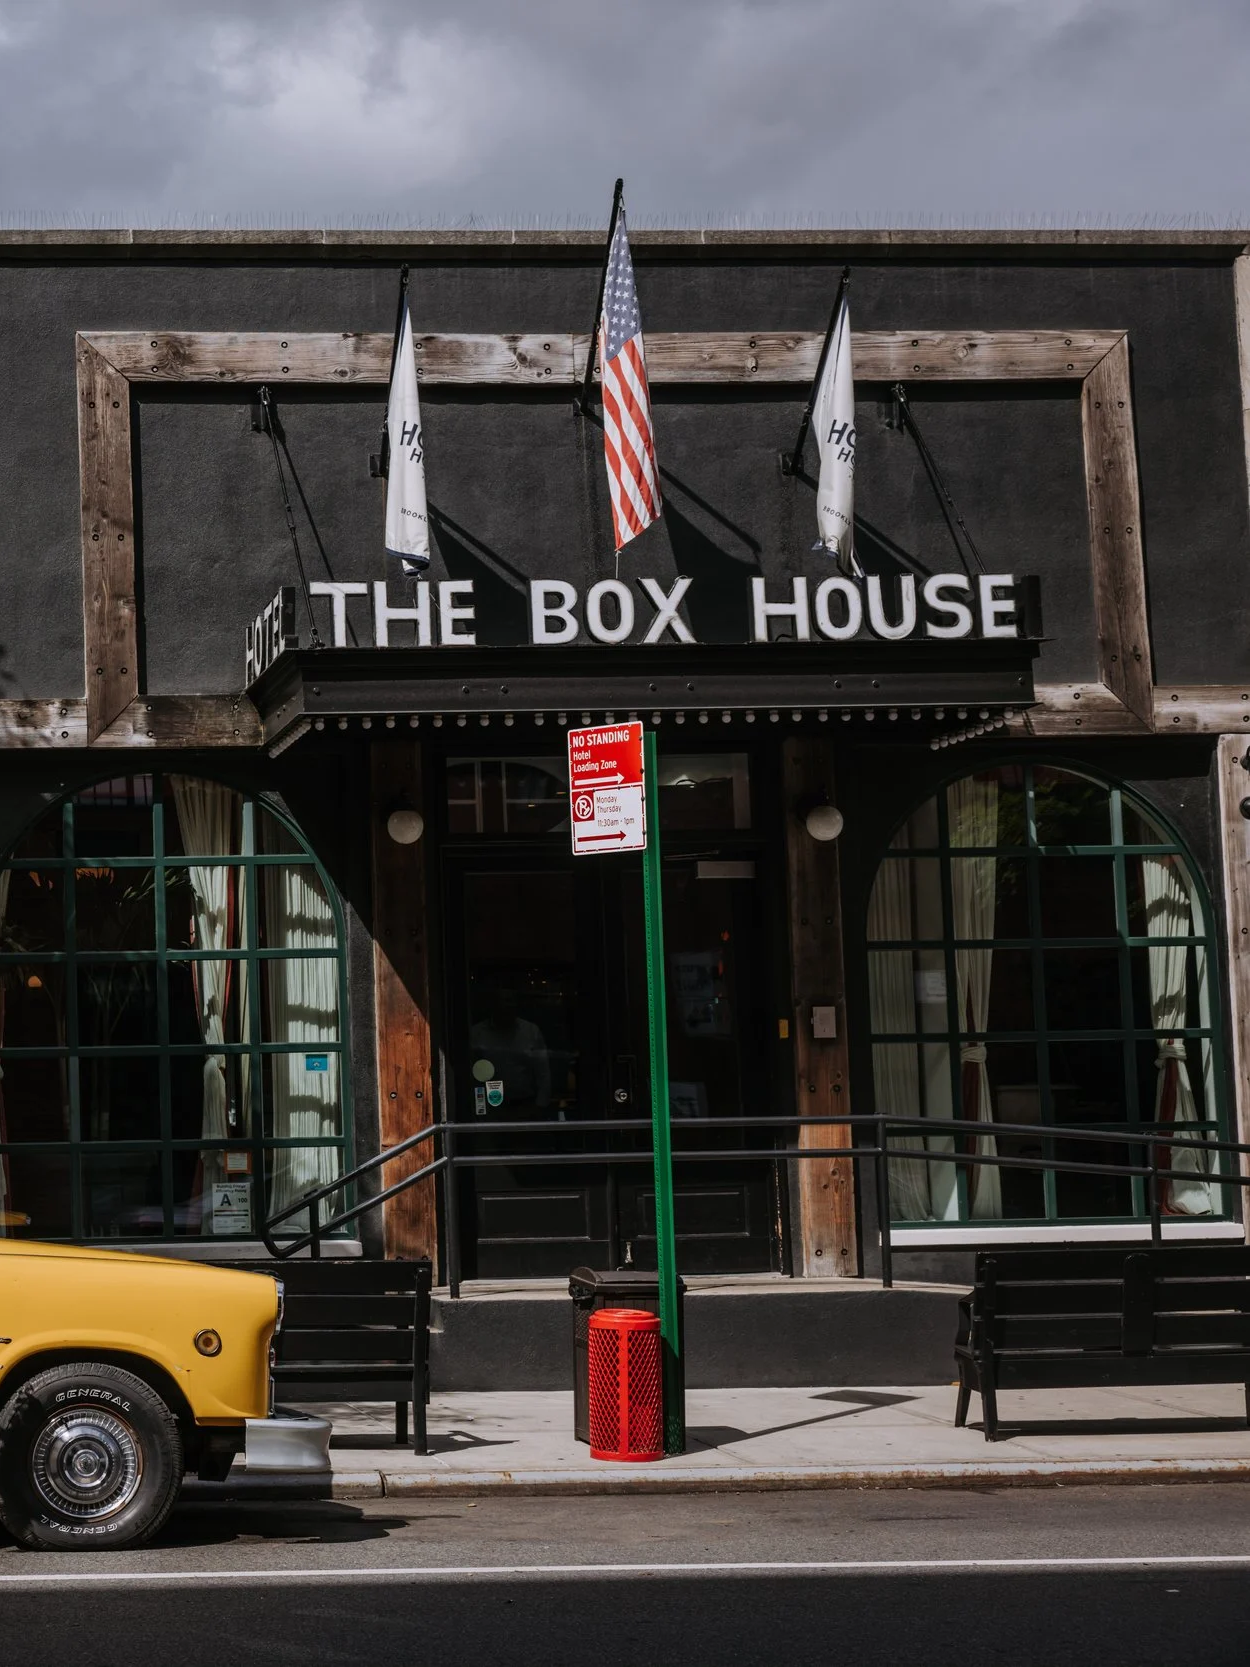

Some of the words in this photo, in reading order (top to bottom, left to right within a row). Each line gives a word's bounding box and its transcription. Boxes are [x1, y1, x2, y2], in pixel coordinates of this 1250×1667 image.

[310, 580, 476, 648] THE
[531, 578, 697, 645] BOX
[751, 573, 1017, 642] HOUSE
[245, 586, 285, 690] HOTEL
[572, 736, 584, 748] NO
[587, 730, 630, 747] STANDING
[573, 750, 591, 761] Hotel
[573, 761, 599, 773] Loading
[600, 760, 617, 770] Zone
[596, 796, 617, 804] Monday
[597, 805, 622, 814] Thursday
[598, 818, 619, 827] 11:30am
[623, 817, 635, 826] 1pm
[220, 1193, 231, 1206] A
[55, 1388, 131, 1412] GENERAL
[40, 1514, 118, 1534] GENERAL
